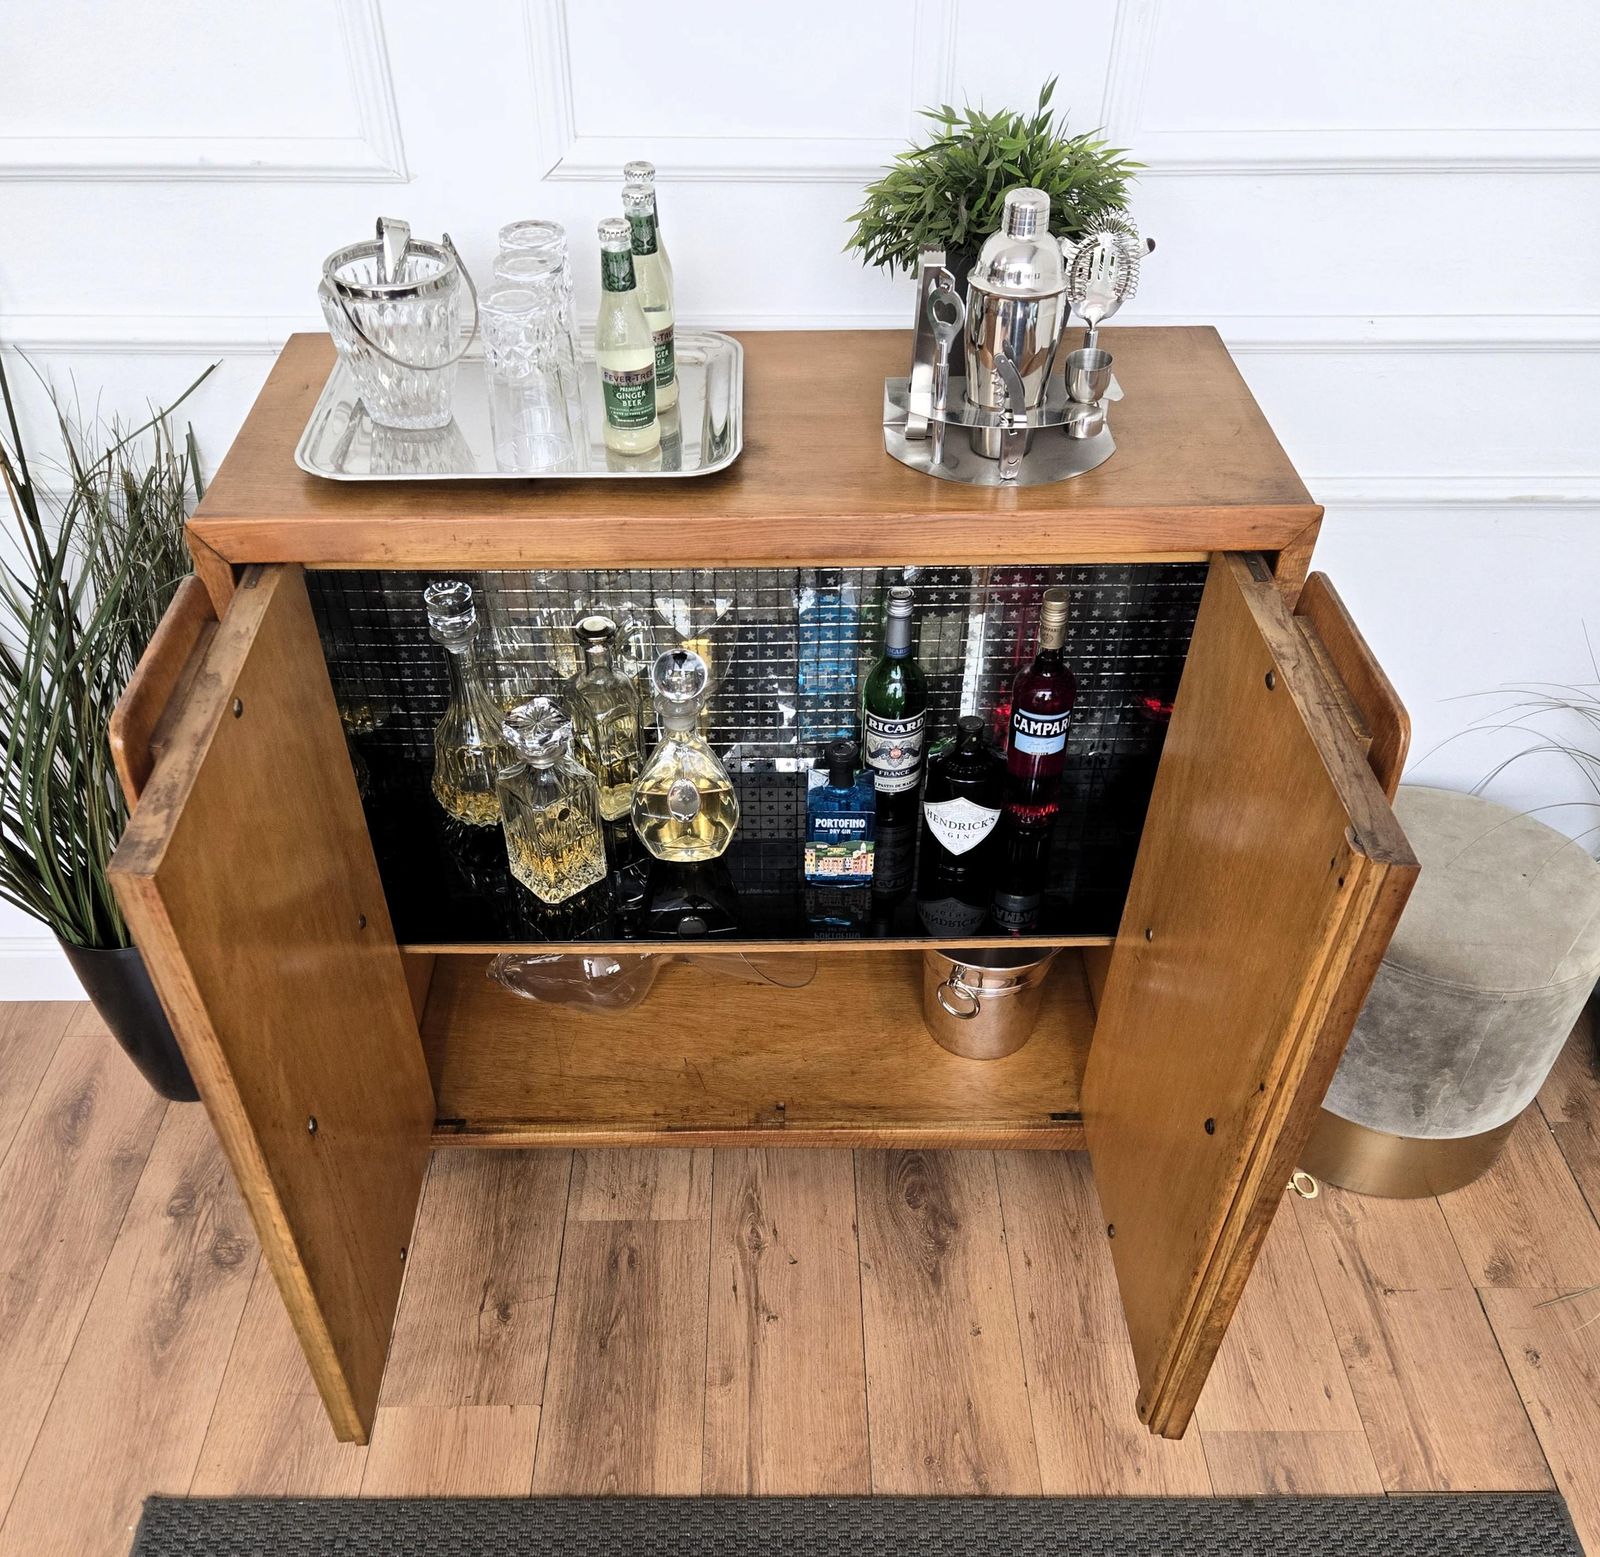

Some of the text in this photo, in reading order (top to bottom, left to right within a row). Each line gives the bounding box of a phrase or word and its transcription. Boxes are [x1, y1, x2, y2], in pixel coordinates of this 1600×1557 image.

[656, 350, 668, 358] GER
[604, 369, 653, 383] FEVER-TREE
[616, 390, 646, 399] GINGER
[622, 399, 642, 407] BEER
[868, 717, 924, 733] RICARD
[1013, 713, 1072, 736] CAMPARI
[879, 769, 910, 777] FRANCE
[815, 818, 866, 828] PORTOFINO
[926, 808, 996, 831] HENDRICK'S
